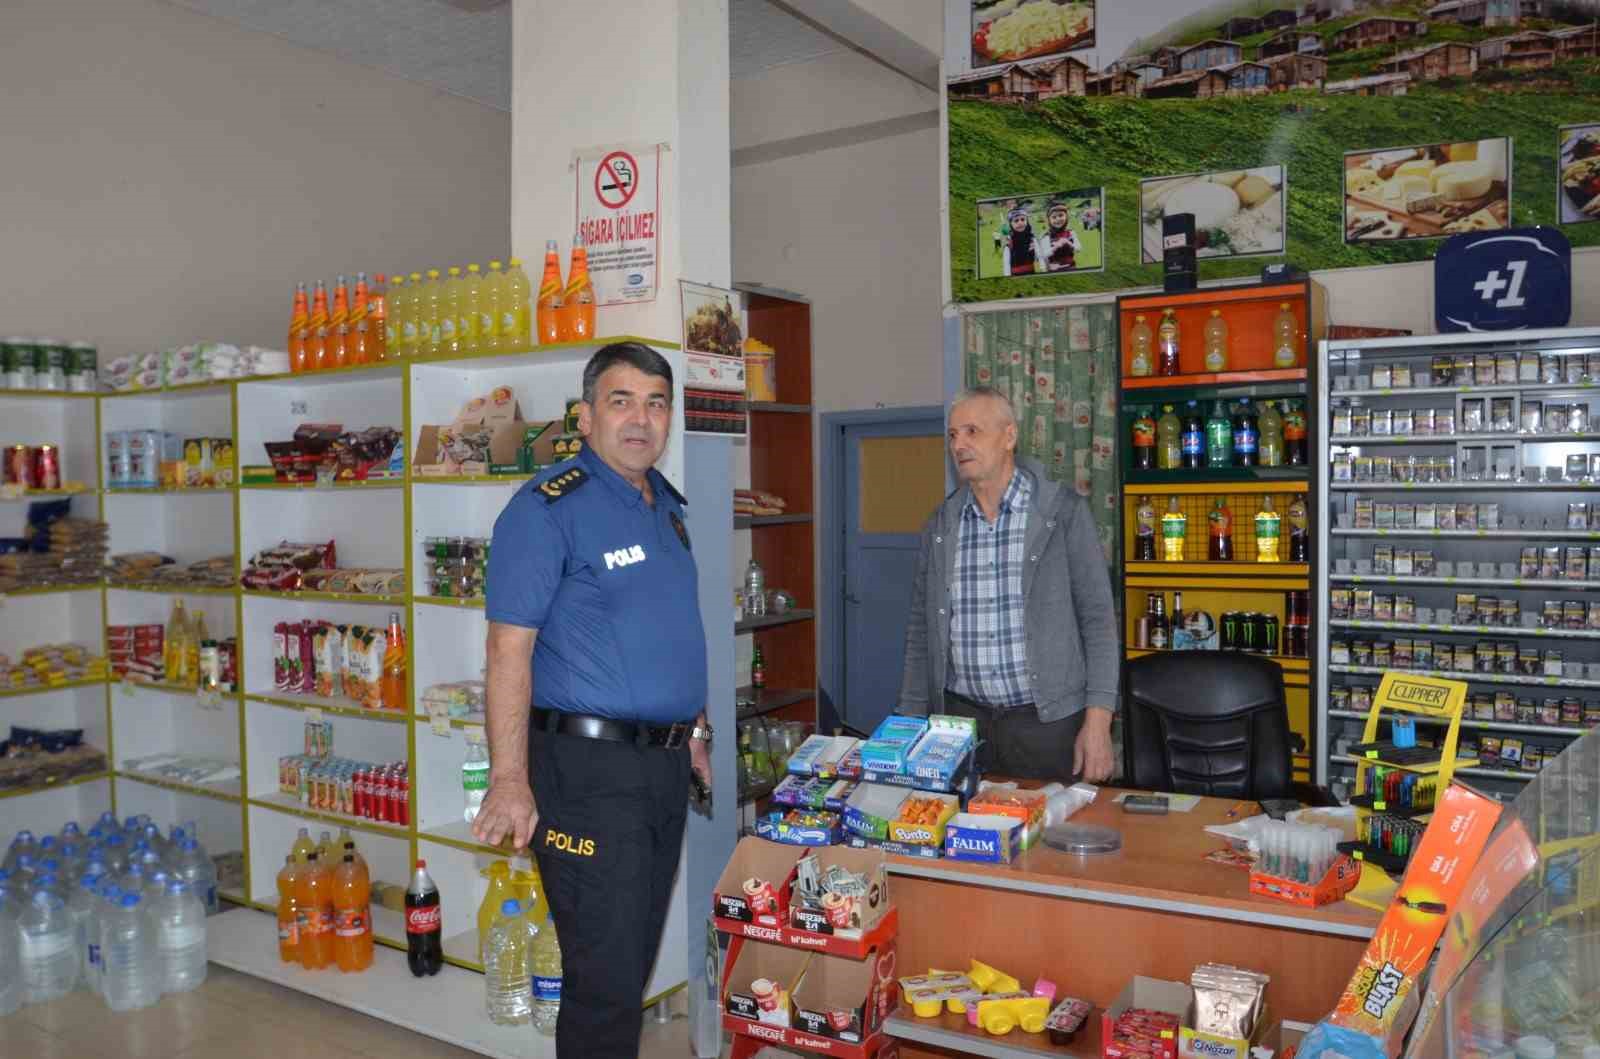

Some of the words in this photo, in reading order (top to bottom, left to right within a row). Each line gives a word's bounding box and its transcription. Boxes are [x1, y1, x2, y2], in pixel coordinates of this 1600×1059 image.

[616, 209, 655, 248] İÇİLMEZ
[1473, 260, 1528, 308] +1
[952, 836, 994, 852] FALIM
[1363, 961, 1404, 1019] BLAST
